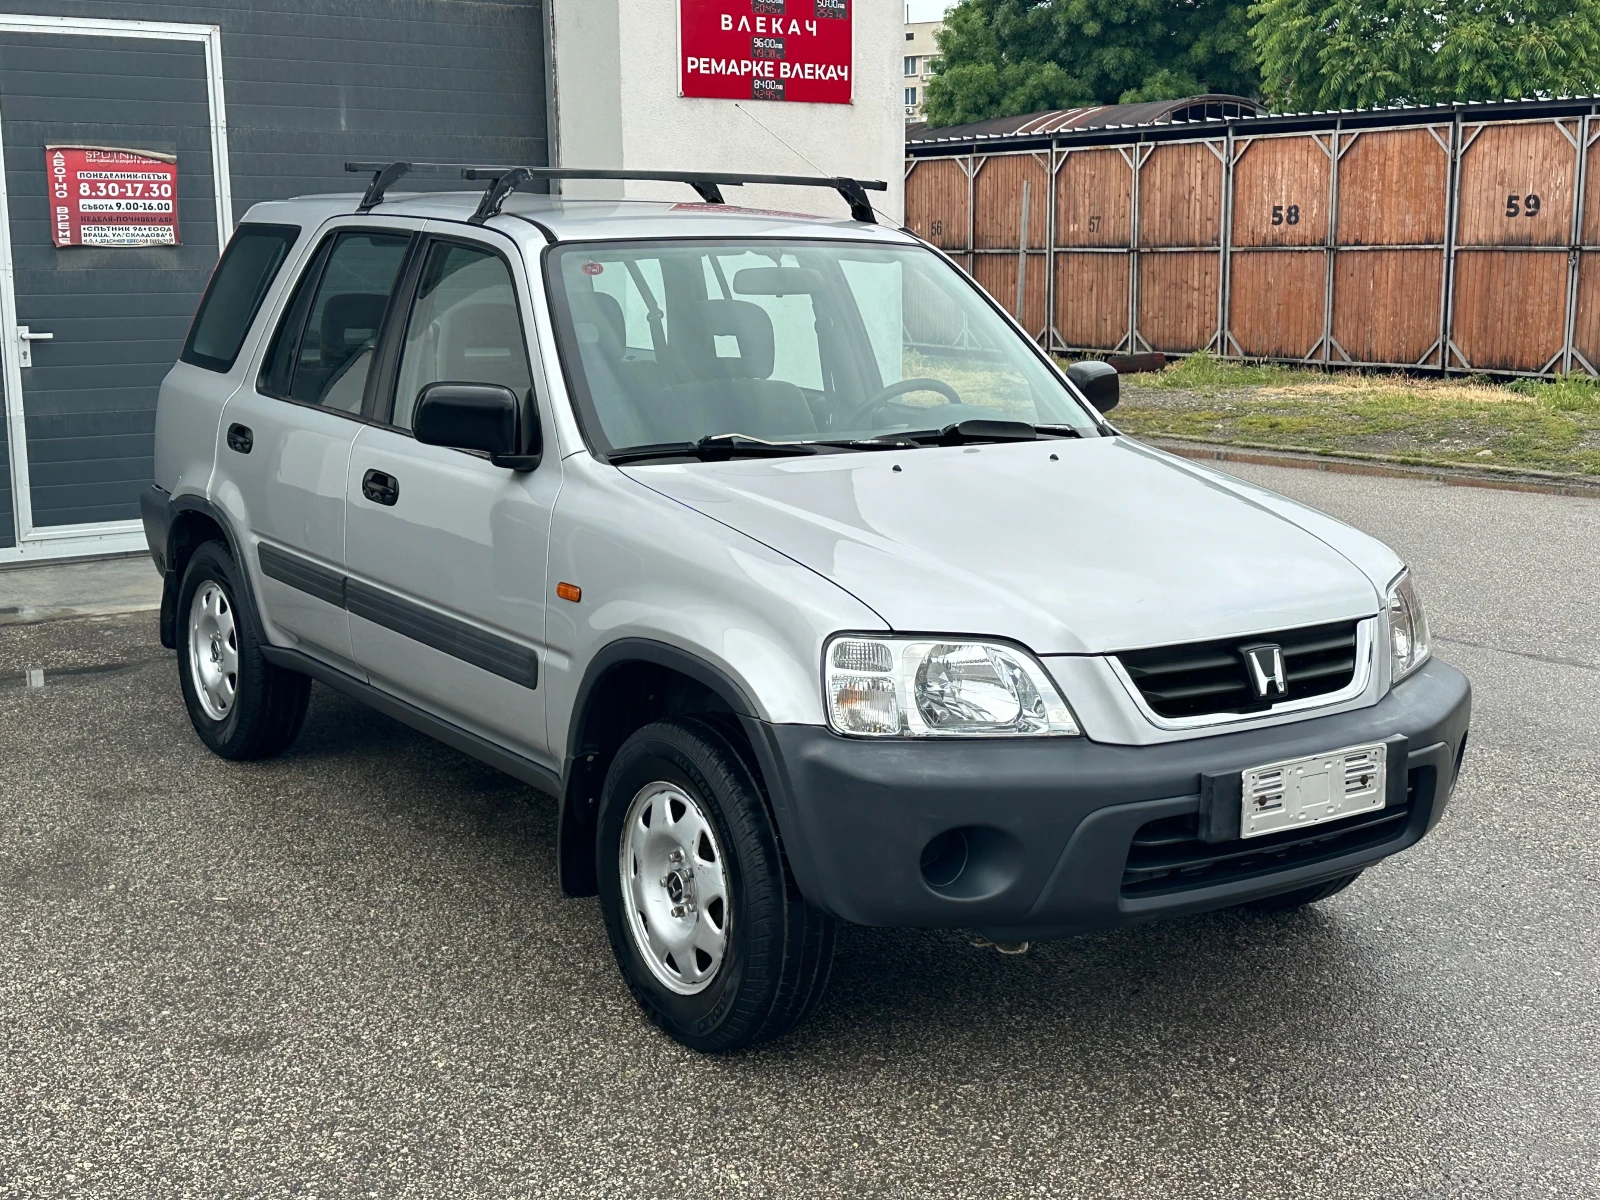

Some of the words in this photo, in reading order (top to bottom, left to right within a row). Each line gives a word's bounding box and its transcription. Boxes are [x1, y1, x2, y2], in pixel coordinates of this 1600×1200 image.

[720, 14, 817, 36] ВЛЕКАЧ
[687, 56, 775, 78] РЕМАРКЕ
[779, 62, 849, 81] ВЛЕКАЧ
[79, 172, 168, 180] ПОНЕДЕЛНИК-ПЕТЪК
[79, 182, 172, 197] 8.30-17.30
[81, 203, 114, 211] СЪБОТА
[115, 202, 170, 211] 9.00-16.00
[1271, 204, 1300, 225] 58
[1505, 194, 1541, 217] 59
[56, 206, 71, 244] ВРЕМЕ
[931, 220, 942, 236] 56
[1088, 216, 1101, 233] 57
